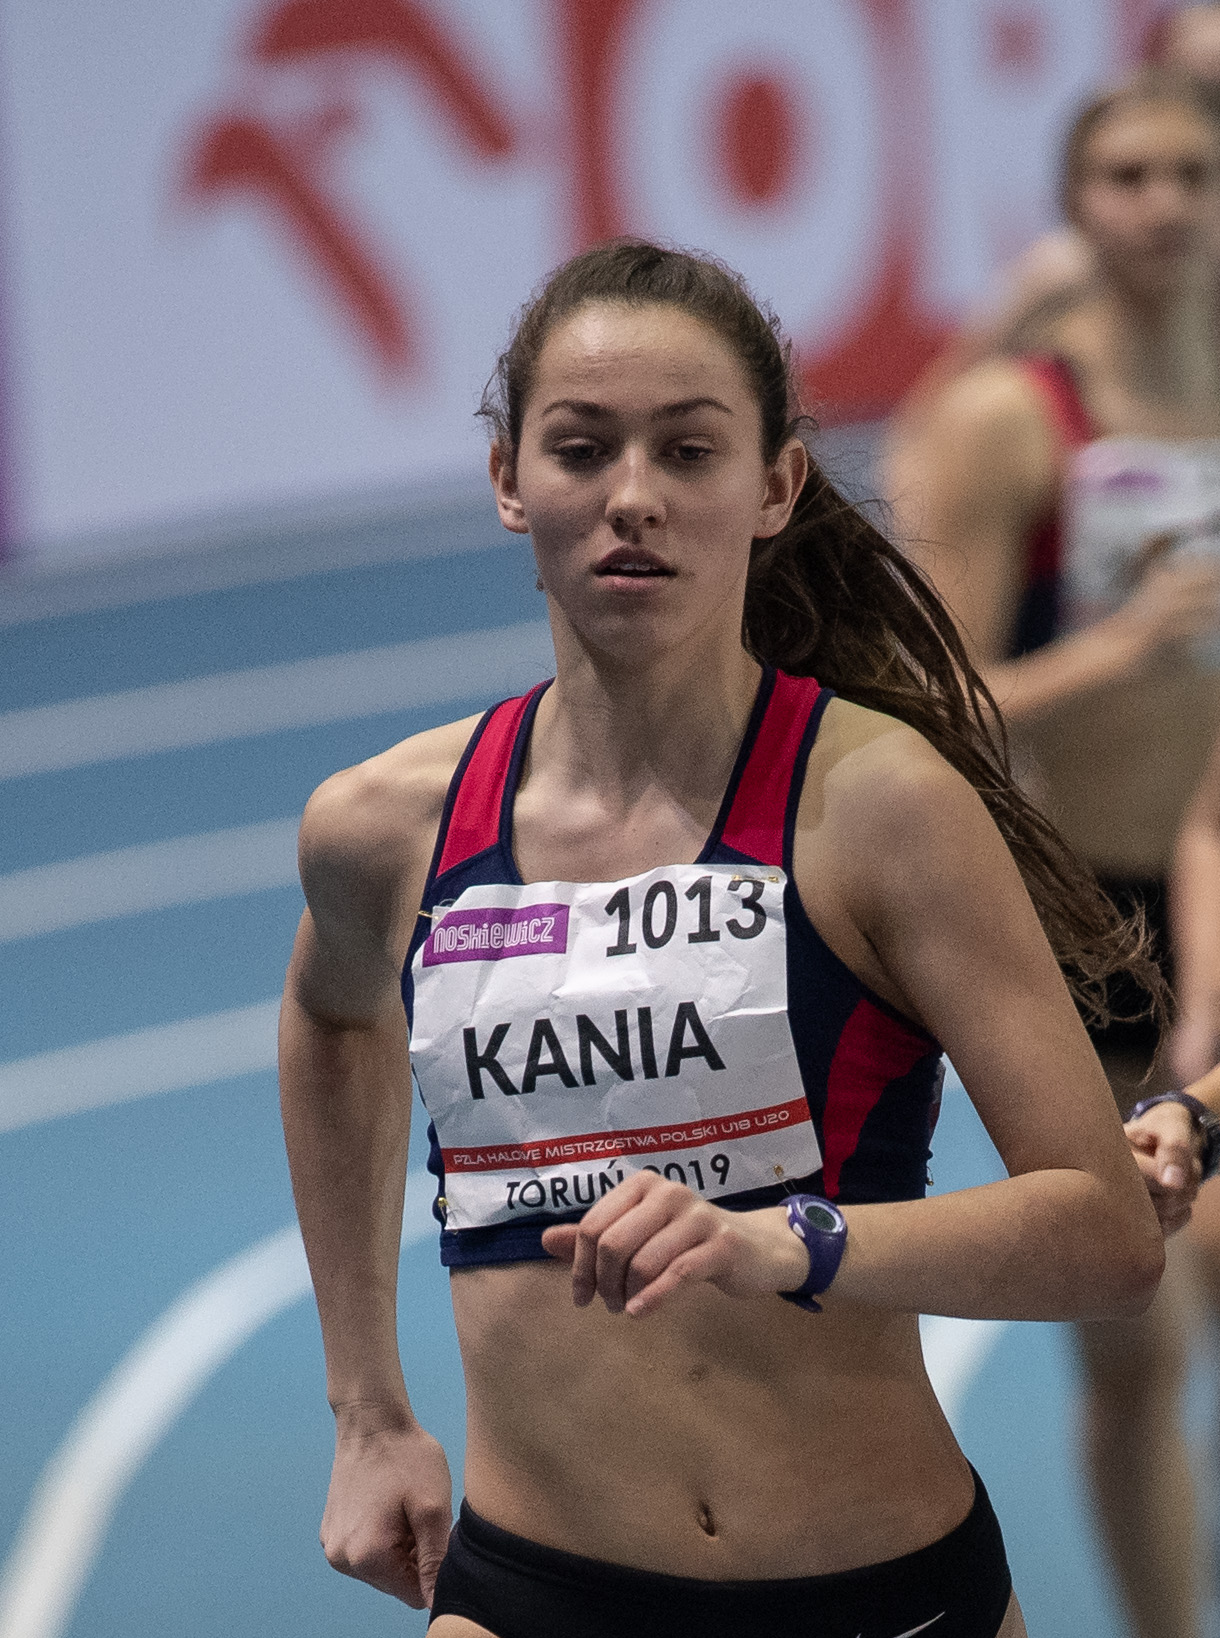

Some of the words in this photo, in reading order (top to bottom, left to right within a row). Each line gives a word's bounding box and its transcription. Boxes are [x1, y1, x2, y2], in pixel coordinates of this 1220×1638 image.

[605, 876, 769, 958] 1013
[462, 1001, 728, 1100] KANIA
[453, 1151, 487, 1166] PZLA
[544, 1133, 657, 1160] MISTRZOSTWA
[660, 1124, 718, 1144] POLSKI
[720, 1117, 752, 1134] U18
[754, 1108, 791, 1127] U20
[642, 1153, 731, 1190] 019
